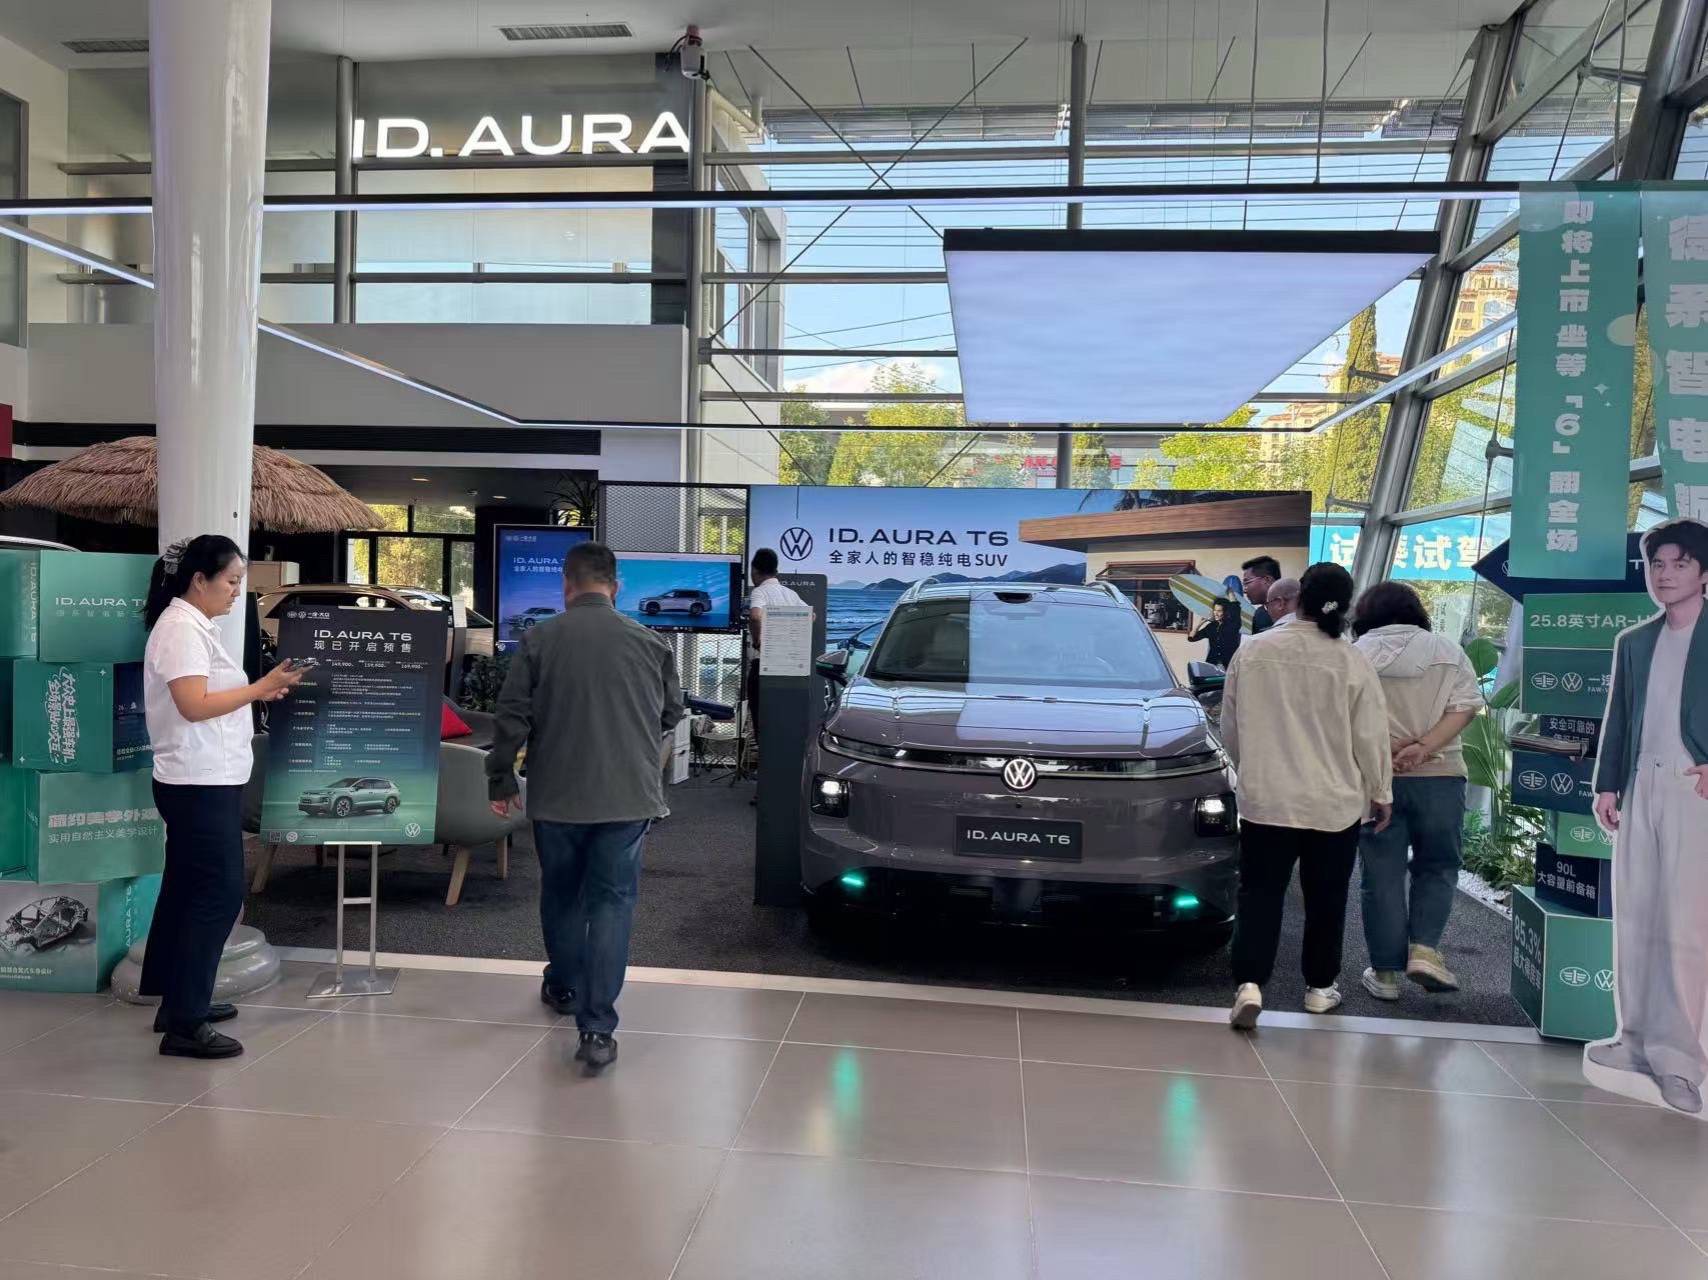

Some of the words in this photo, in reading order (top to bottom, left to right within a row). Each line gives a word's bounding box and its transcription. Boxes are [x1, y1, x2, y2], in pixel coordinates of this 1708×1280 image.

[967, 530, 1009, 546] T6
[389, 632, 412, 641] T6
[314, 641, 411, 653] 现已开启预售
[1549, 717, 1595, 735] 安全可靠的
[1046, 834, 1071, 845] T6
[1556, 861, 1577, 877] 90L
[1514, 914, 1542, 964] 85.3%
